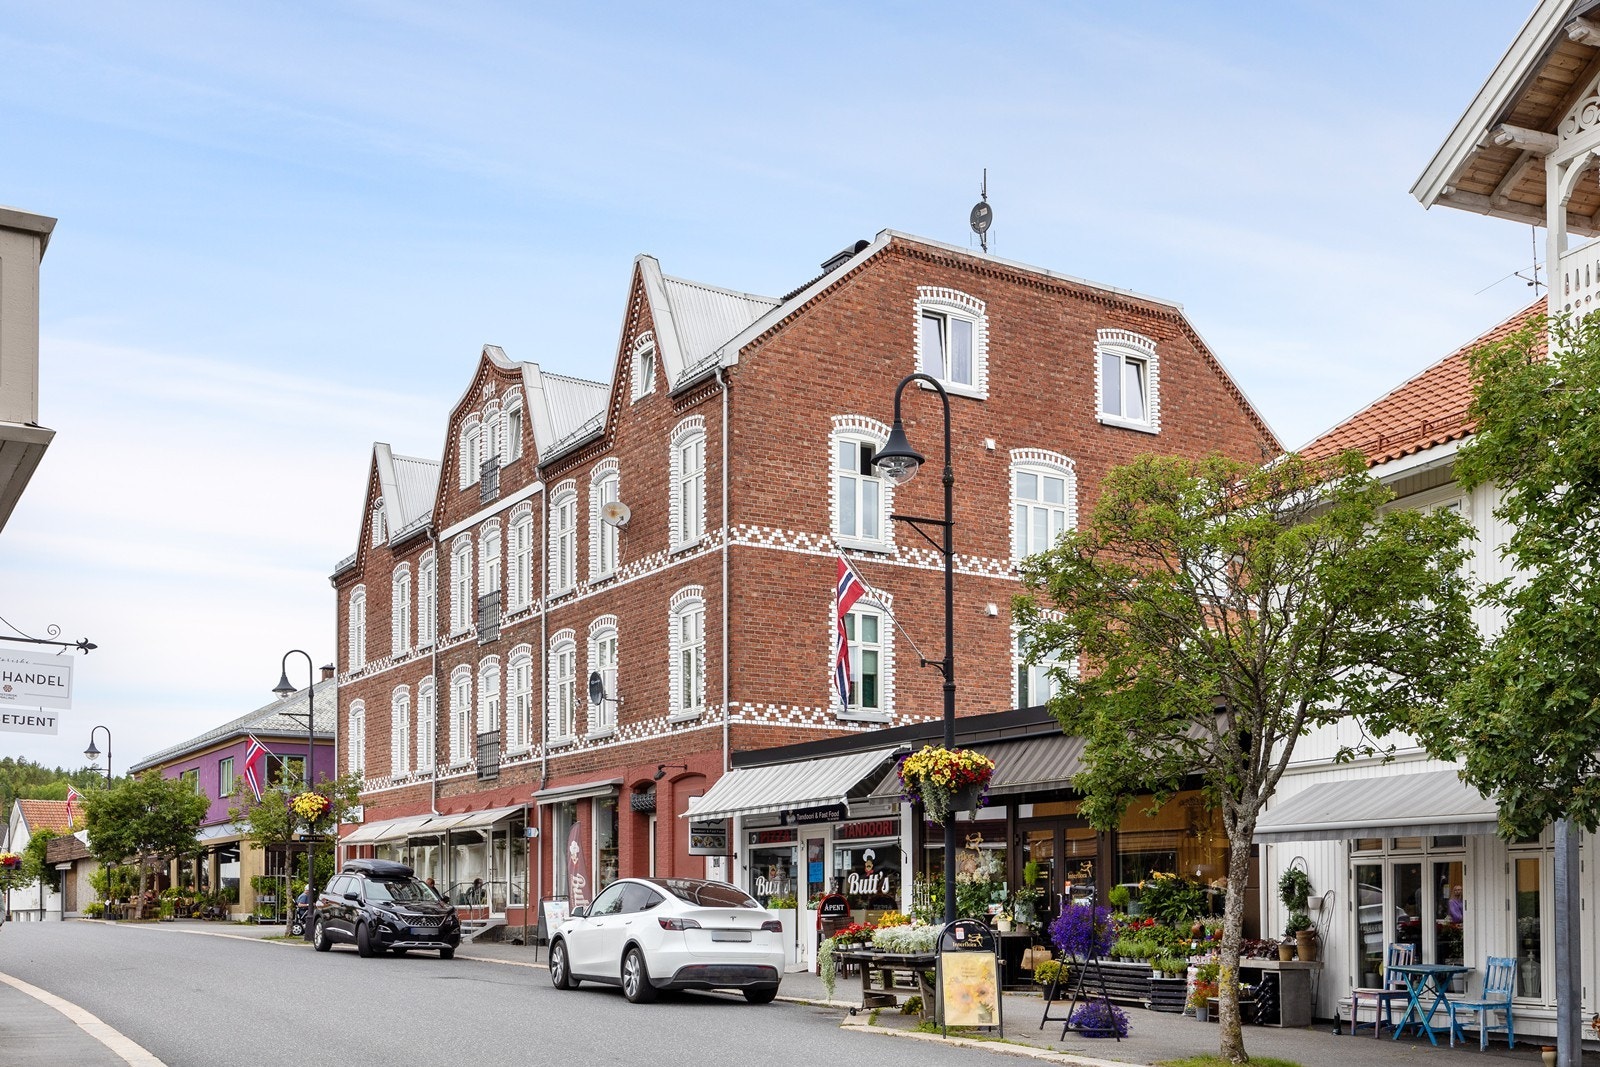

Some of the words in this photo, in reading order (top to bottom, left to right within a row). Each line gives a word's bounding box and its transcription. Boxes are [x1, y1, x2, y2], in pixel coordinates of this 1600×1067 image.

[797, 812, 814, 820] Tandoori
[819, 811, 828, 819] Fast
[829, 810, 839, 818] Food
[760, 829, 791, 843] PIZZA
[844, 821, 893, 837] TANDOORI
[848, 871, 890, 894] Butt's
[824, 903, 845, 911] ÅPENT
